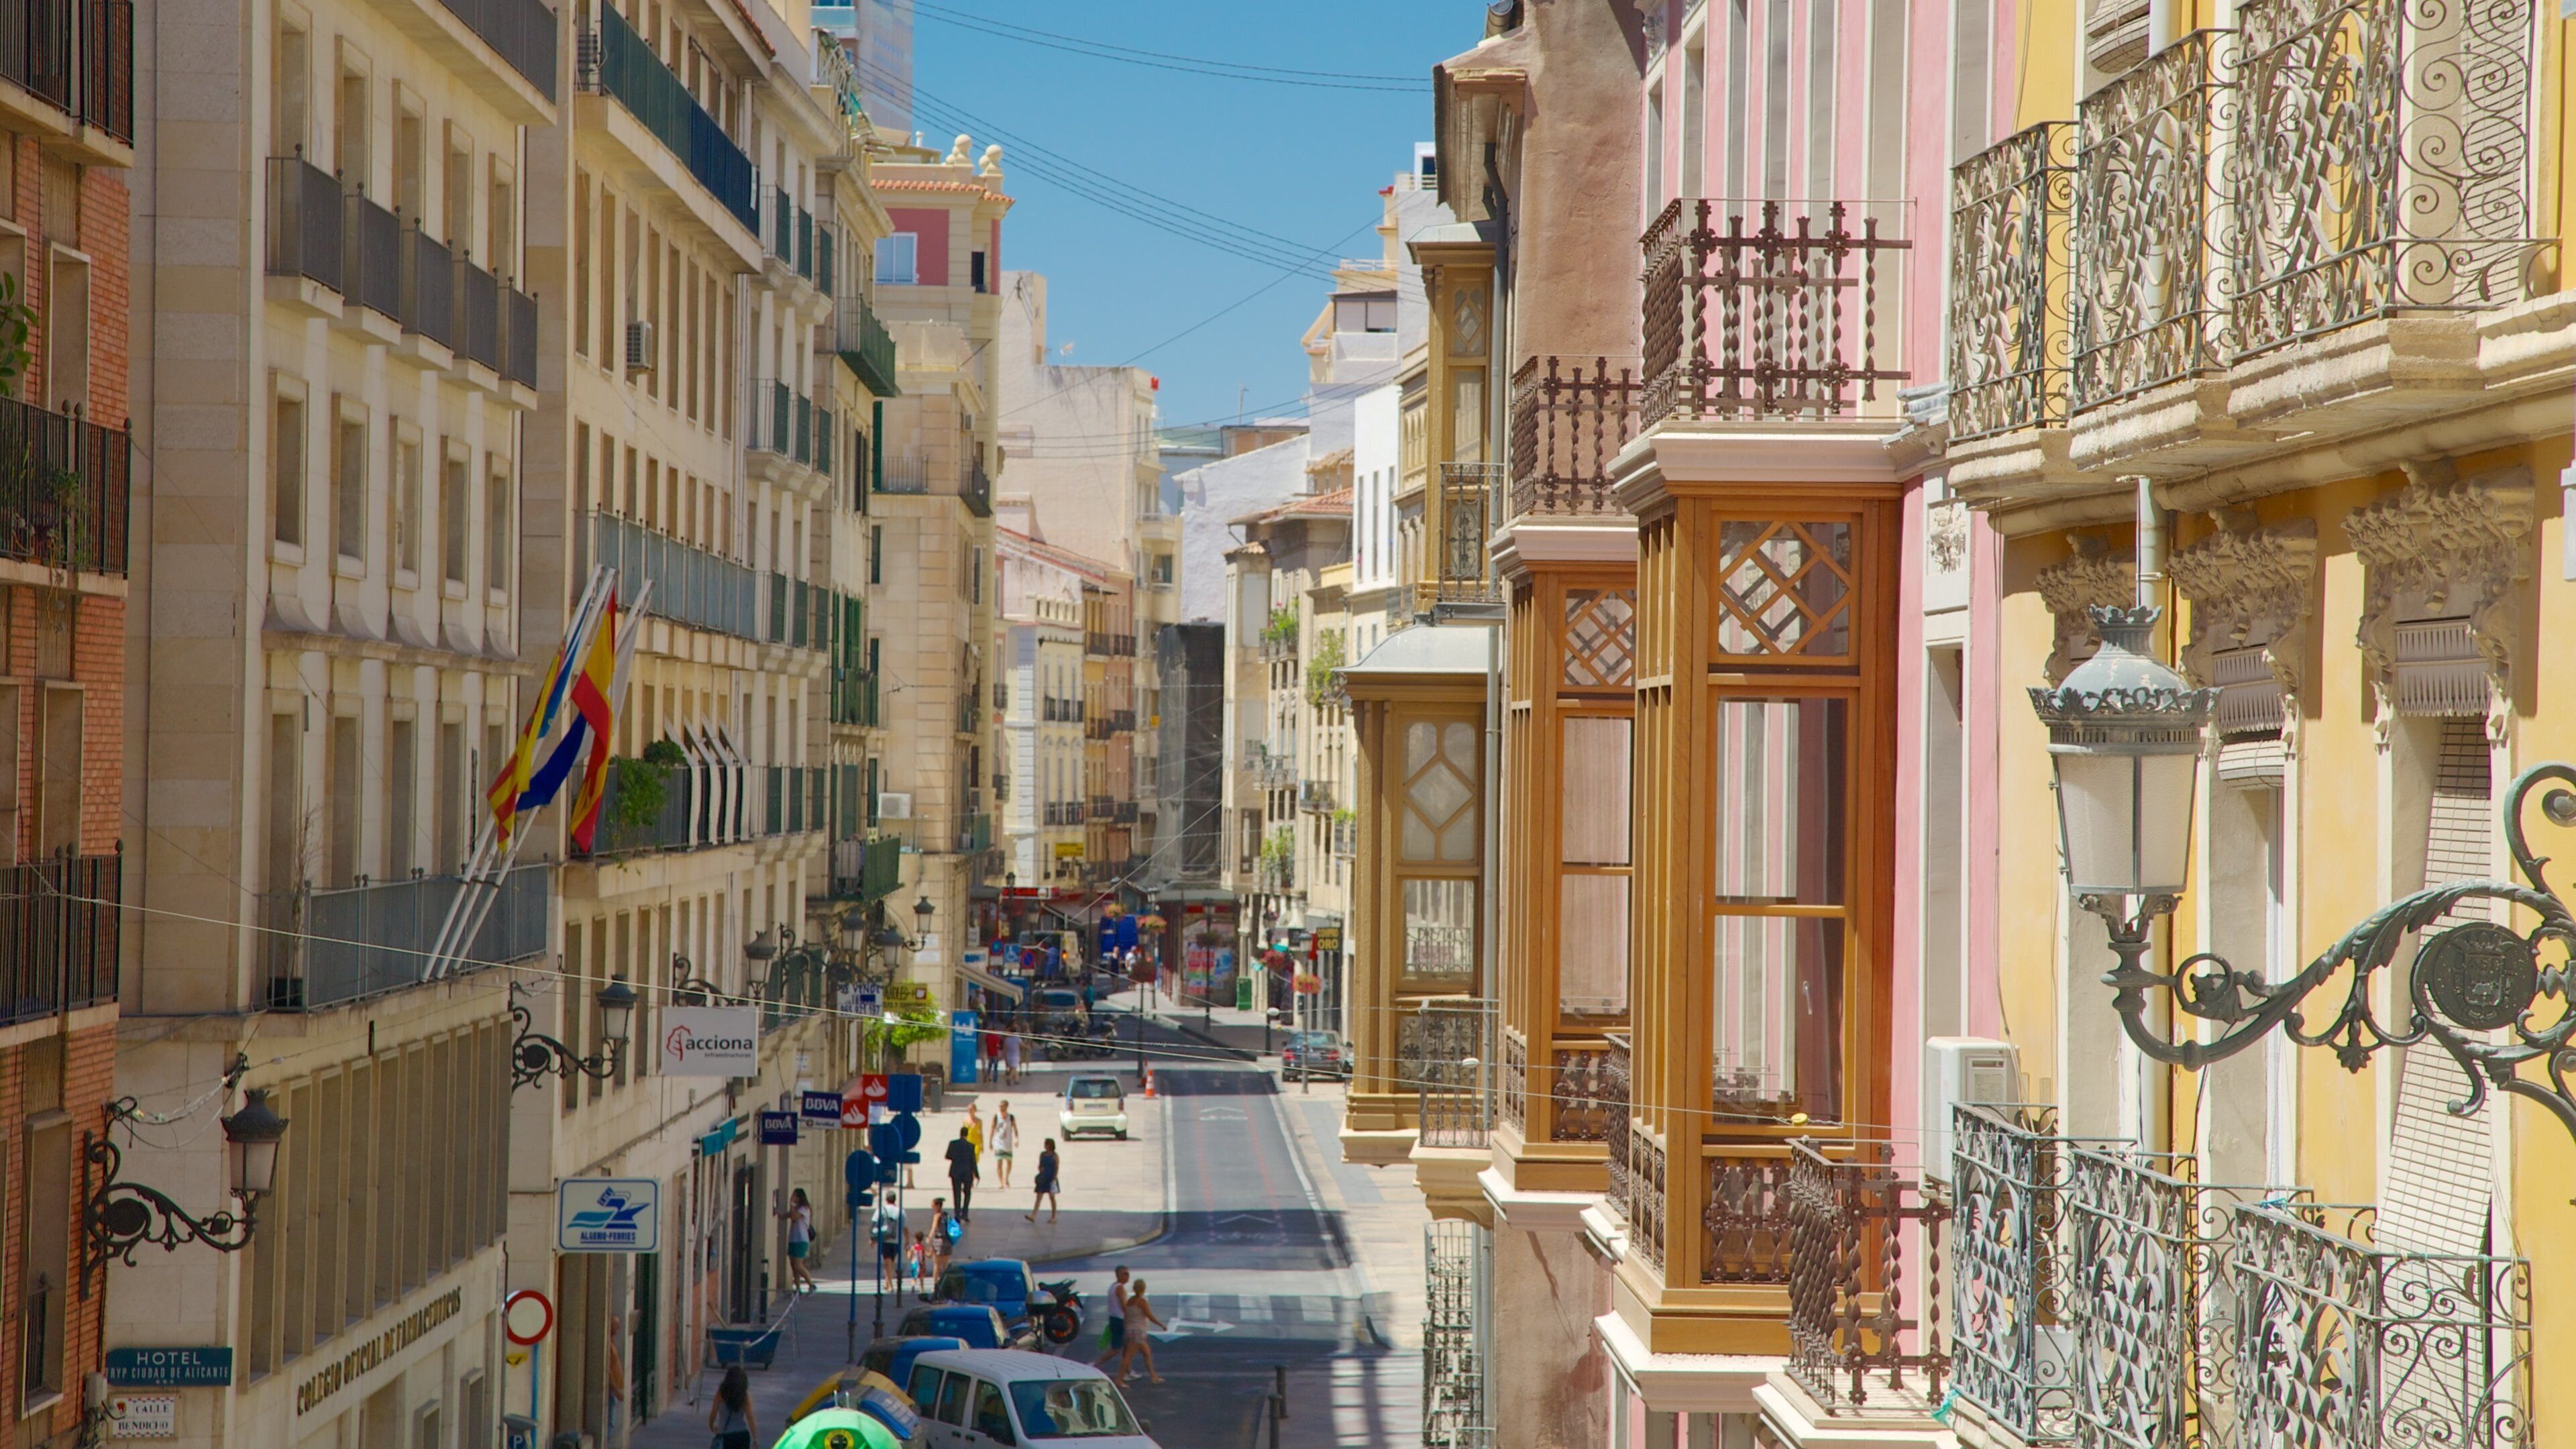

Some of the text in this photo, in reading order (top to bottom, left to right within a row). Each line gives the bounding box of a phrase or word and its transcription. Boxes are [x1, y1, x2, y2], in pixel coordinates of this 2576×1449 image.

[1318, 939, 1338, 950] ORO
[853, 983, 880, 994] VENDE
[686, 1035, 753, 1050] acciona
[805, 1097, 839, 1112] BBVA
[765, 1118, 792, 1129] BBVA
[297, 1285, 462, 1416] COLEGIO OFICIAL DE FARMACEUTICOS
[137, 1352, 201, 1365] HOTEL
[131, 1367, 165, 1378] CIUDAD
[170, 1367, 181, 1378] DE
[185, 1366, 229, 1378] ALICANTE
[136, 1405, 168, 1413] CALLE
[118, 1421, 168, 1430] BENDICHO
[514, 1434, 523, 1449] P
